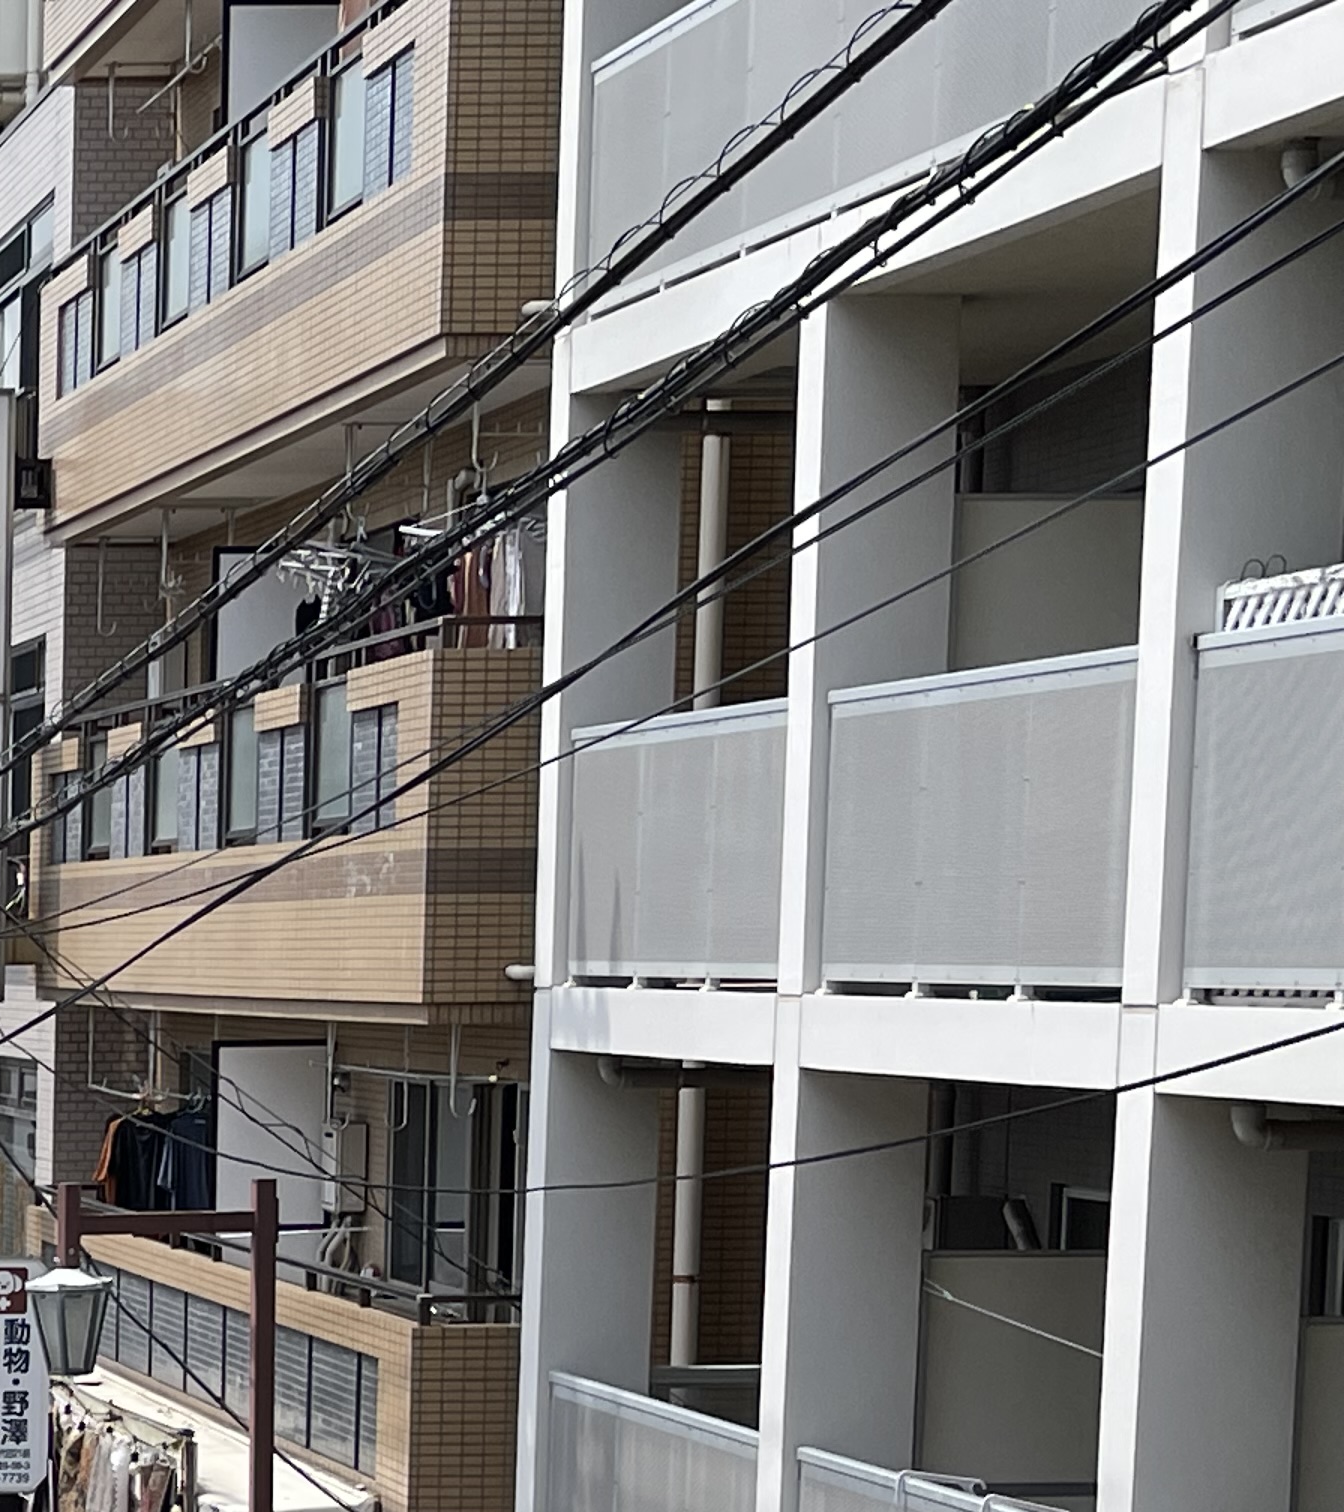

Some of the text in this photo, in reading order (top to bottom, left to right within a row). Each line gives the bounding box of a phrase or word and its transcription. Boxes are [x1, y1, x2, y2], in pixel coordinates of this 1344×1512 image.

[1, 1318, 31, 1445] 動物・野澤
